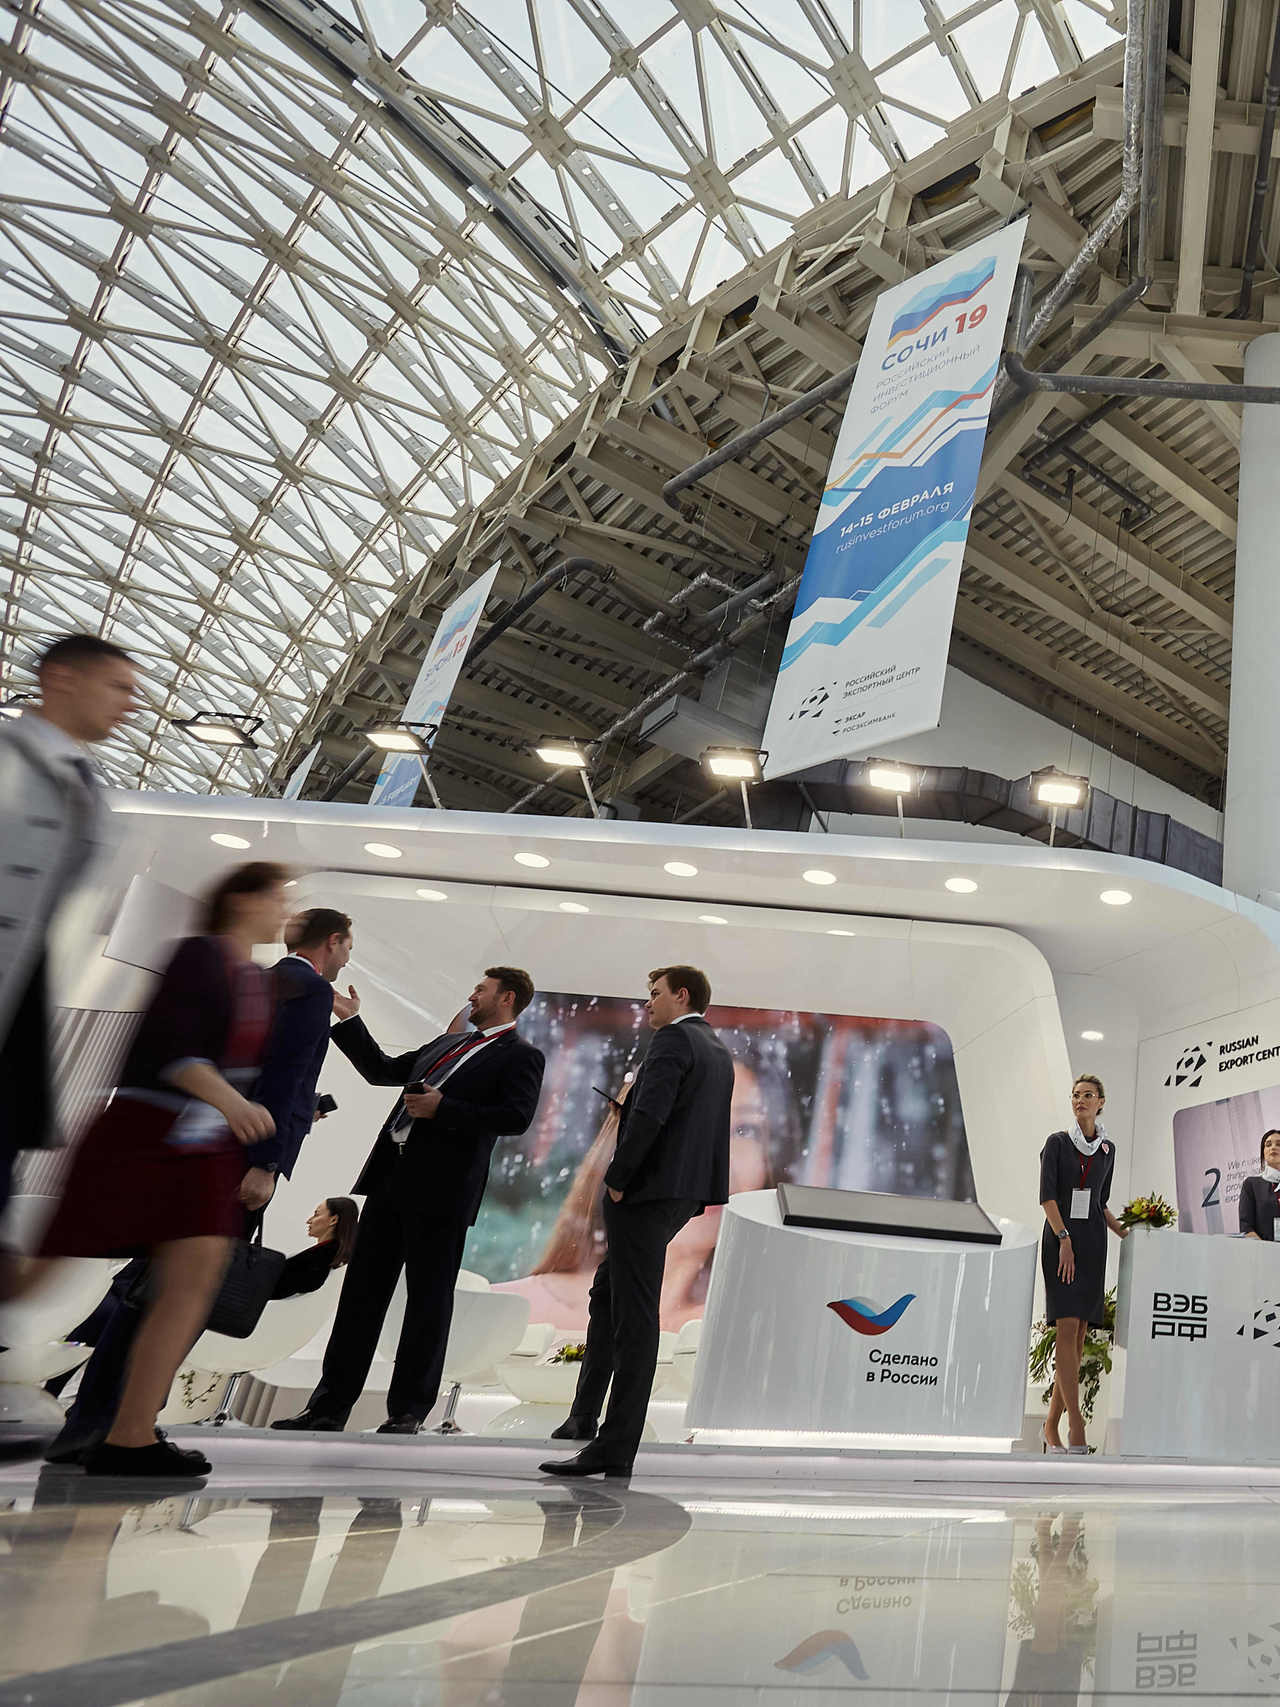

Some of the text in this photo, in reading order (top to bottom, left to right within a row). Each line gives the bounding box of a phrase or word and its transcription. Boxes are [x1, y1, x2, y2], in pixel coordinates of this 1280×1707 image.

[881, 304, 988, 371] СОЧИ 19
[840, 481, 954, 538] 14-15 ФЕВРАЛЯ
[836, 501, 950, 554] rusinvestforum.org
[842, 666, 921, 699] ЭКСПОРТНЫЙ ЦЕНТР
[845, 664, 896, 688] РОССИЙСКИЙ
[1219, 1035, 1259, 1056] RUSSIAN
[1218, 1053, 1255, 1072] EXPORT
[1202, 1167, 1221, 1208] 2
[1152, 1292, 1209, 1315] ВЭБ
[1151, 1320, 1208, 1342] РФ
[869, 1348, 938, 1367] Сделано
[866, 1368, 938, 1386] в России
